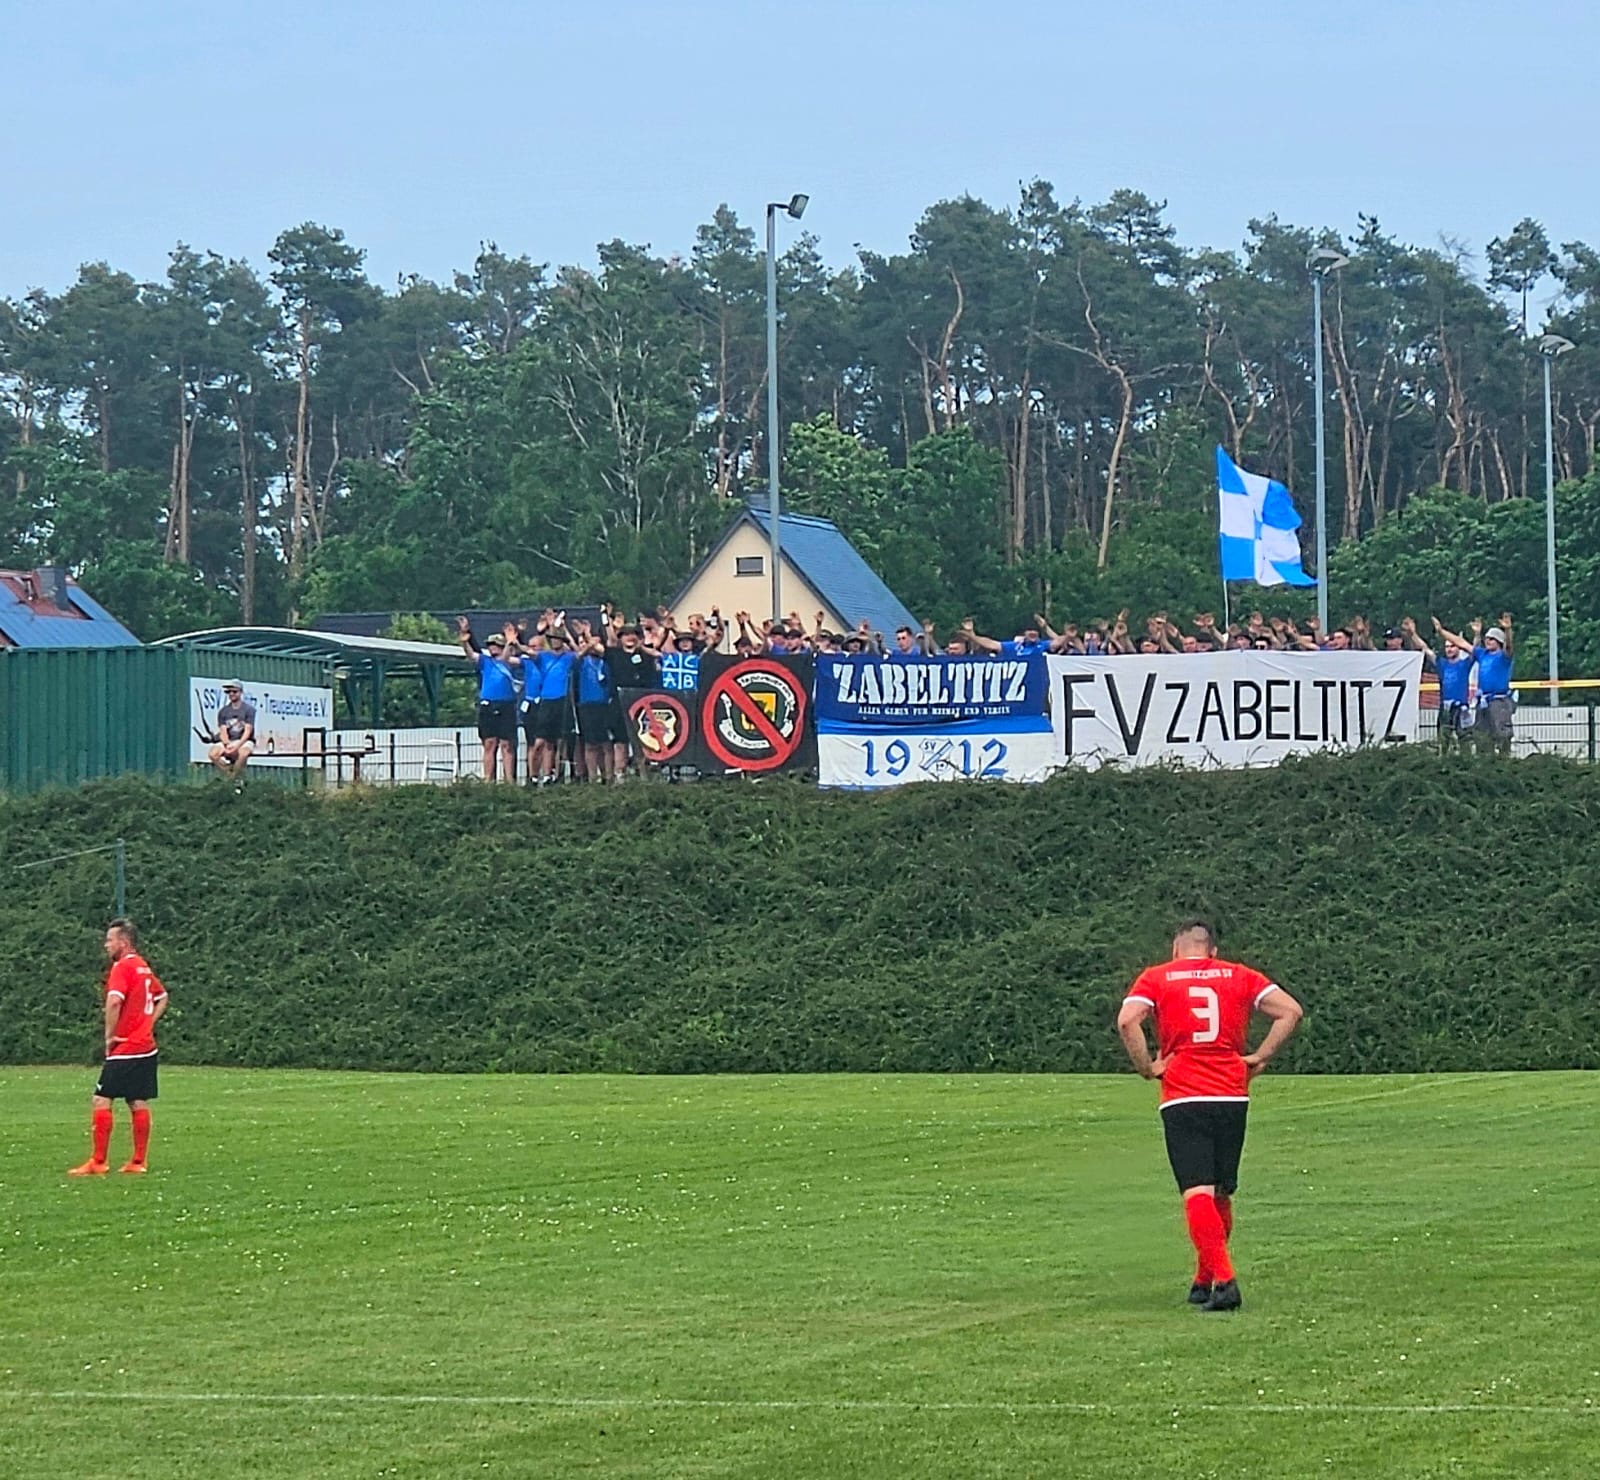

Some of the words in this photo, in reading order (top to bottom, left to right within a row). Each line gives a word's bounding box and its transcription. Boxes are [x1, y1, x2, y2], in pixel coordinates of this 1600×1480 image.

[832, 660, 1029, 706] ZABELTITZ
[1165, 679, 1407, 744] ZABELTITZ
[861, 738, 911, 777] 19
[958, 738, 1008, 777] 12
[1188, 985, 1220, 1043] 3
